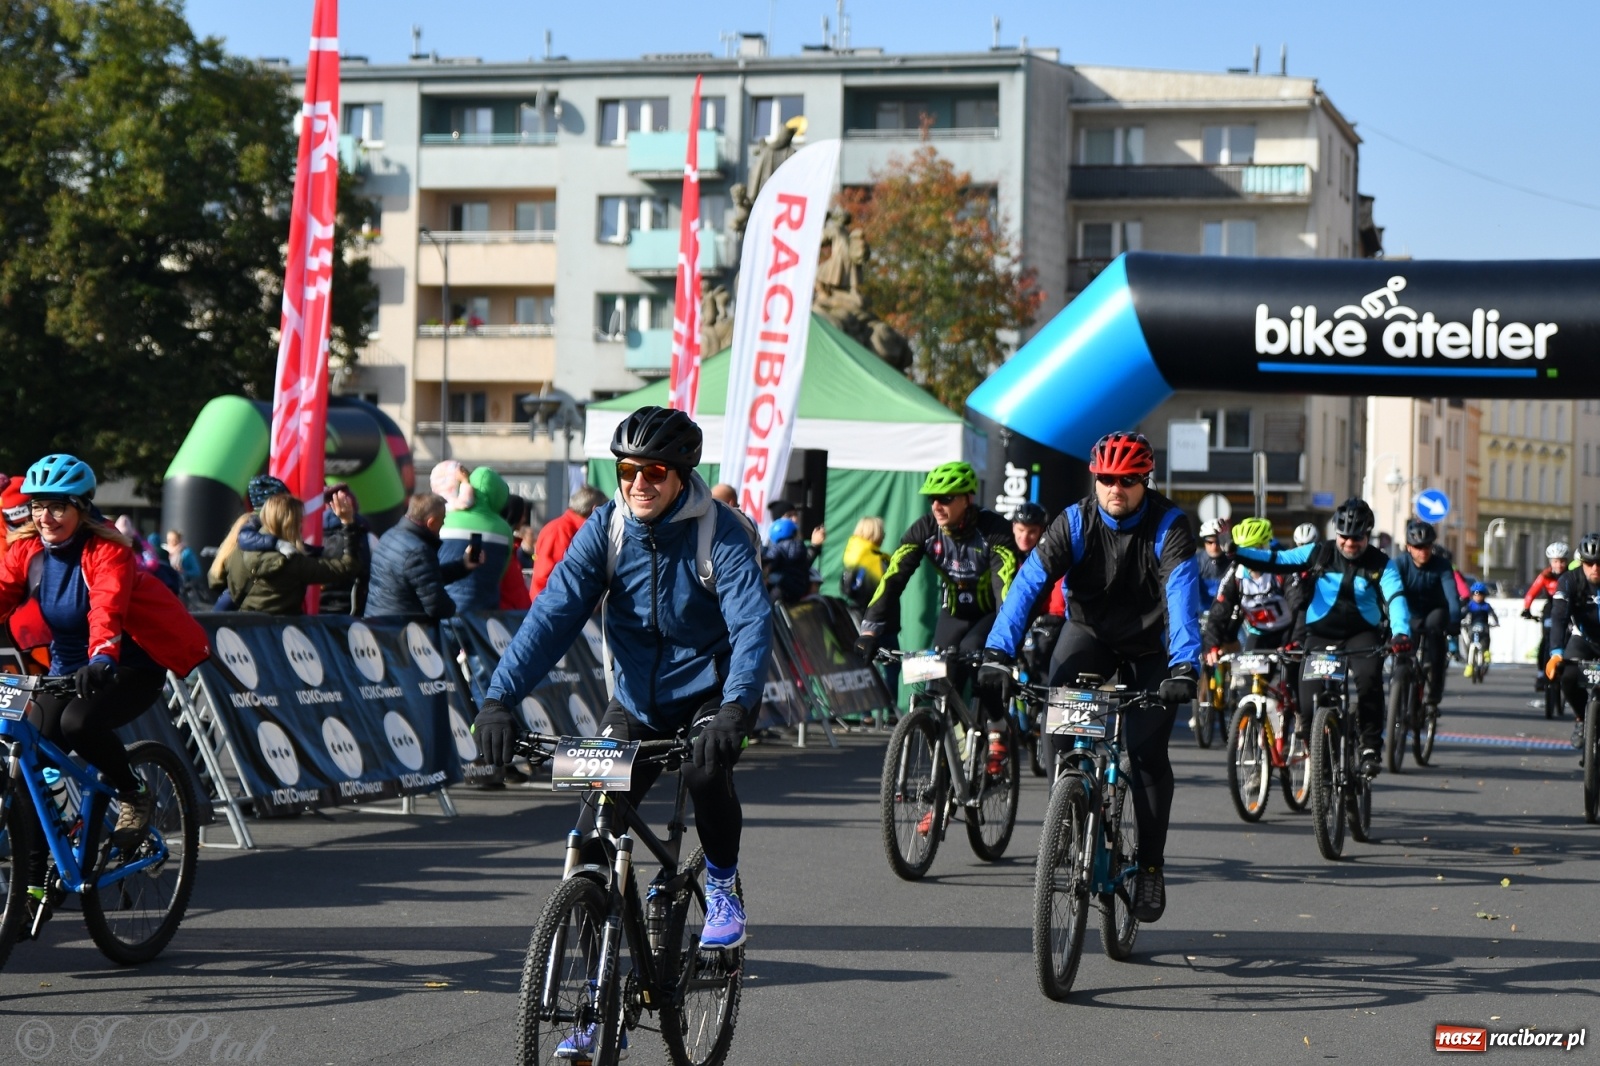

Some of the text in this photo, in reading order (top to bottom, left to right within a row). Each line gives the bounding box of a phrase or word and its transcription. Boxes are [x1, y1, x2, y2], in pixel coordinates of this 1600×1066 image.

[1255, 303, 1558, 360] bike atelier
[741, 193, 807, 524] RACIBÓRZ
[295, 689, 343, 705] KOKOwear
[359, 685, 403, 699] KOKOwear
[1061, 709, 1091, 726] 146
[566, 748, 623, 758] OPIEKUN
[572, 758, 614, 777] 299
[399, 770, 447, 788] KOKOwear
[271, 787, 319, 806] KOKOwear
[339, 780, 383, 797] KOKOwear
